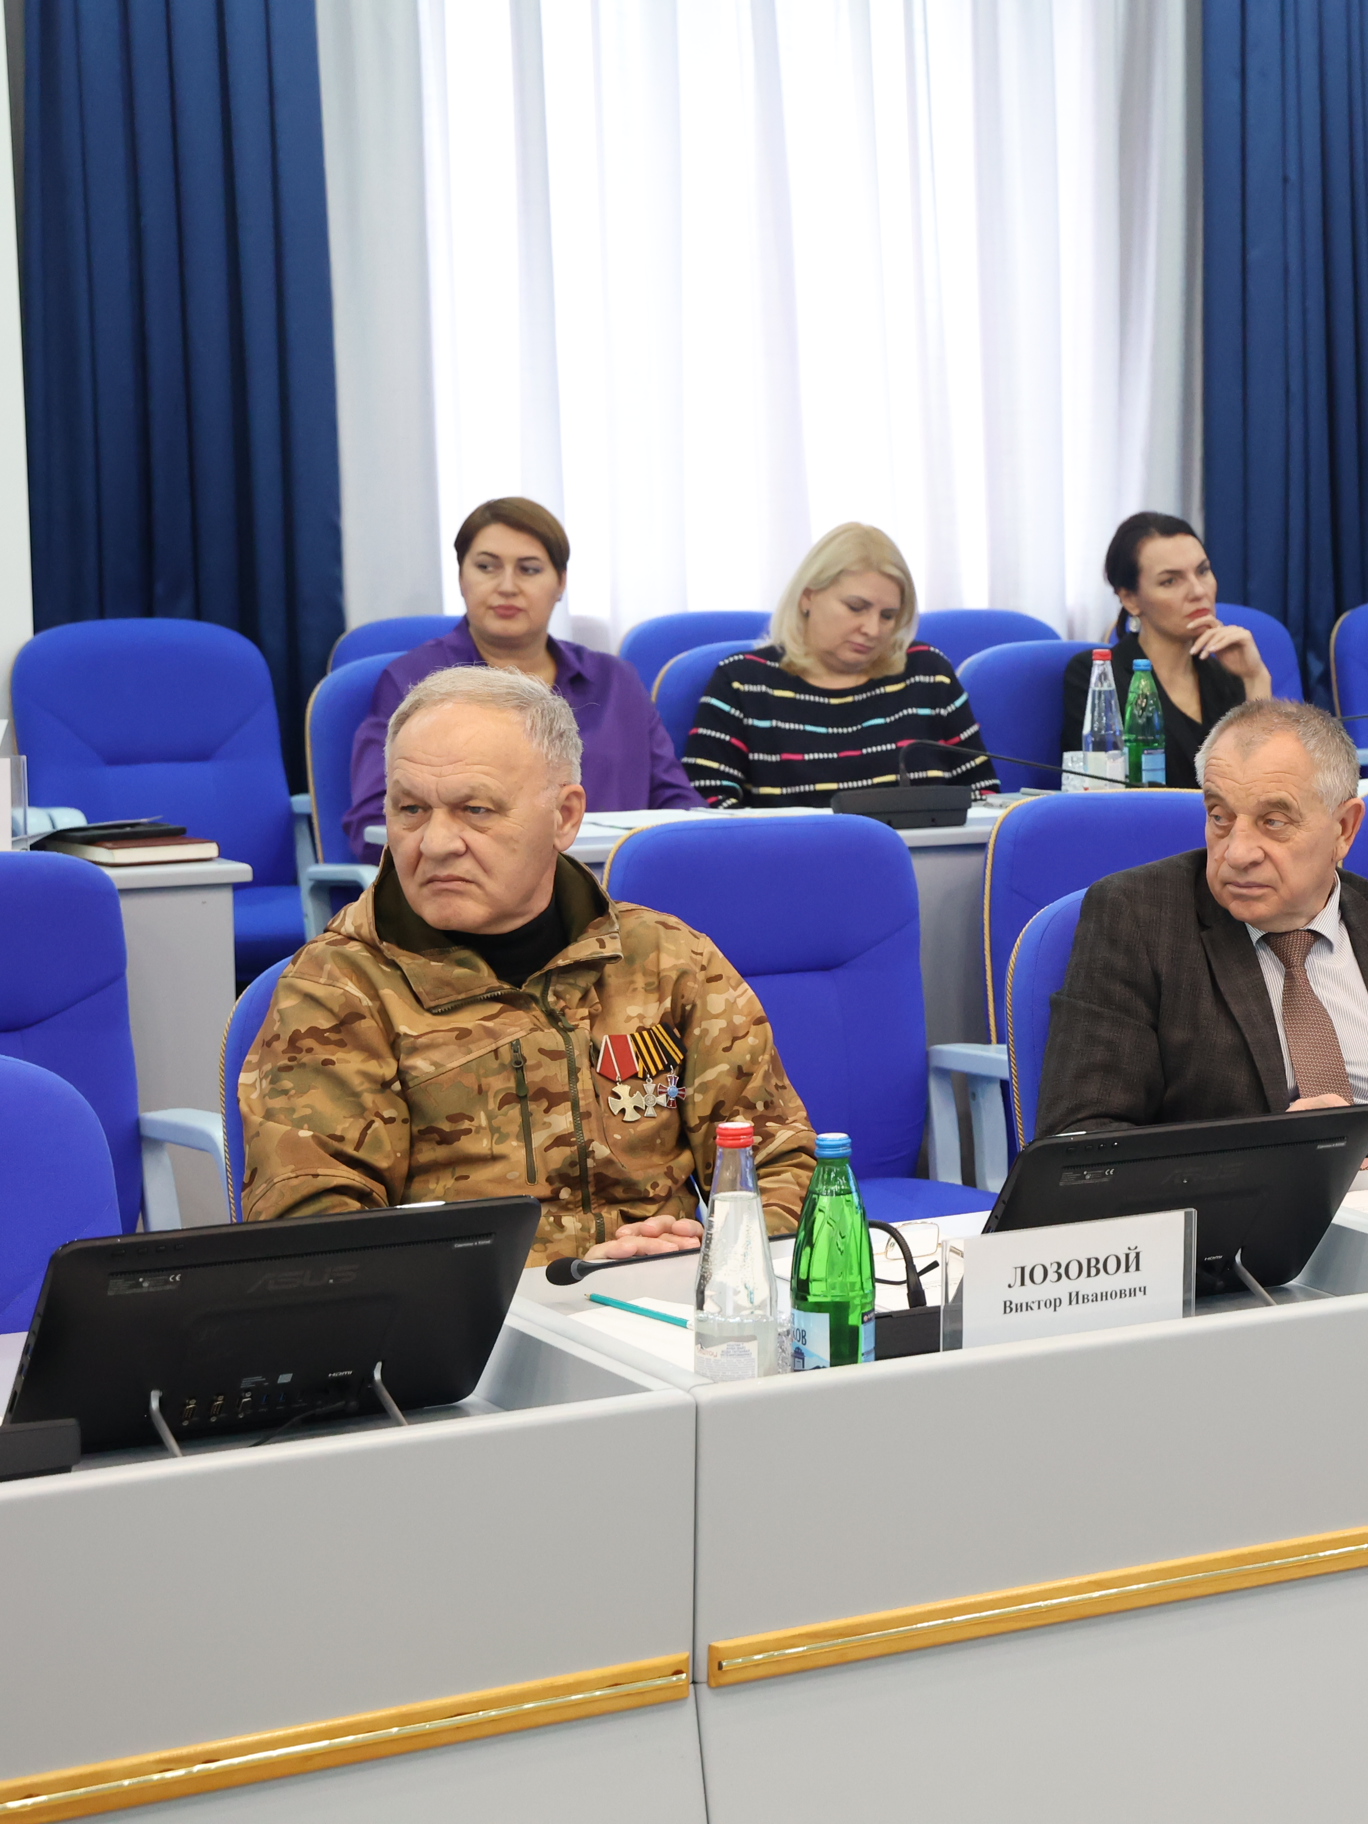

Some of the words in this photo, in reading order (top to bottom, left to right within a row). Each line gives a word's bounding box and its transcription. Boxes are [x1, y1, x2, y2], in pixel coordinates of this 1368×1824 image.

[1007, 1246, 1142, 1288] ЛОЗОВОЙ
[1002, 1296, 1062, 1315] Виктор
[1067, 1285, 1147, 1306] Иванович
